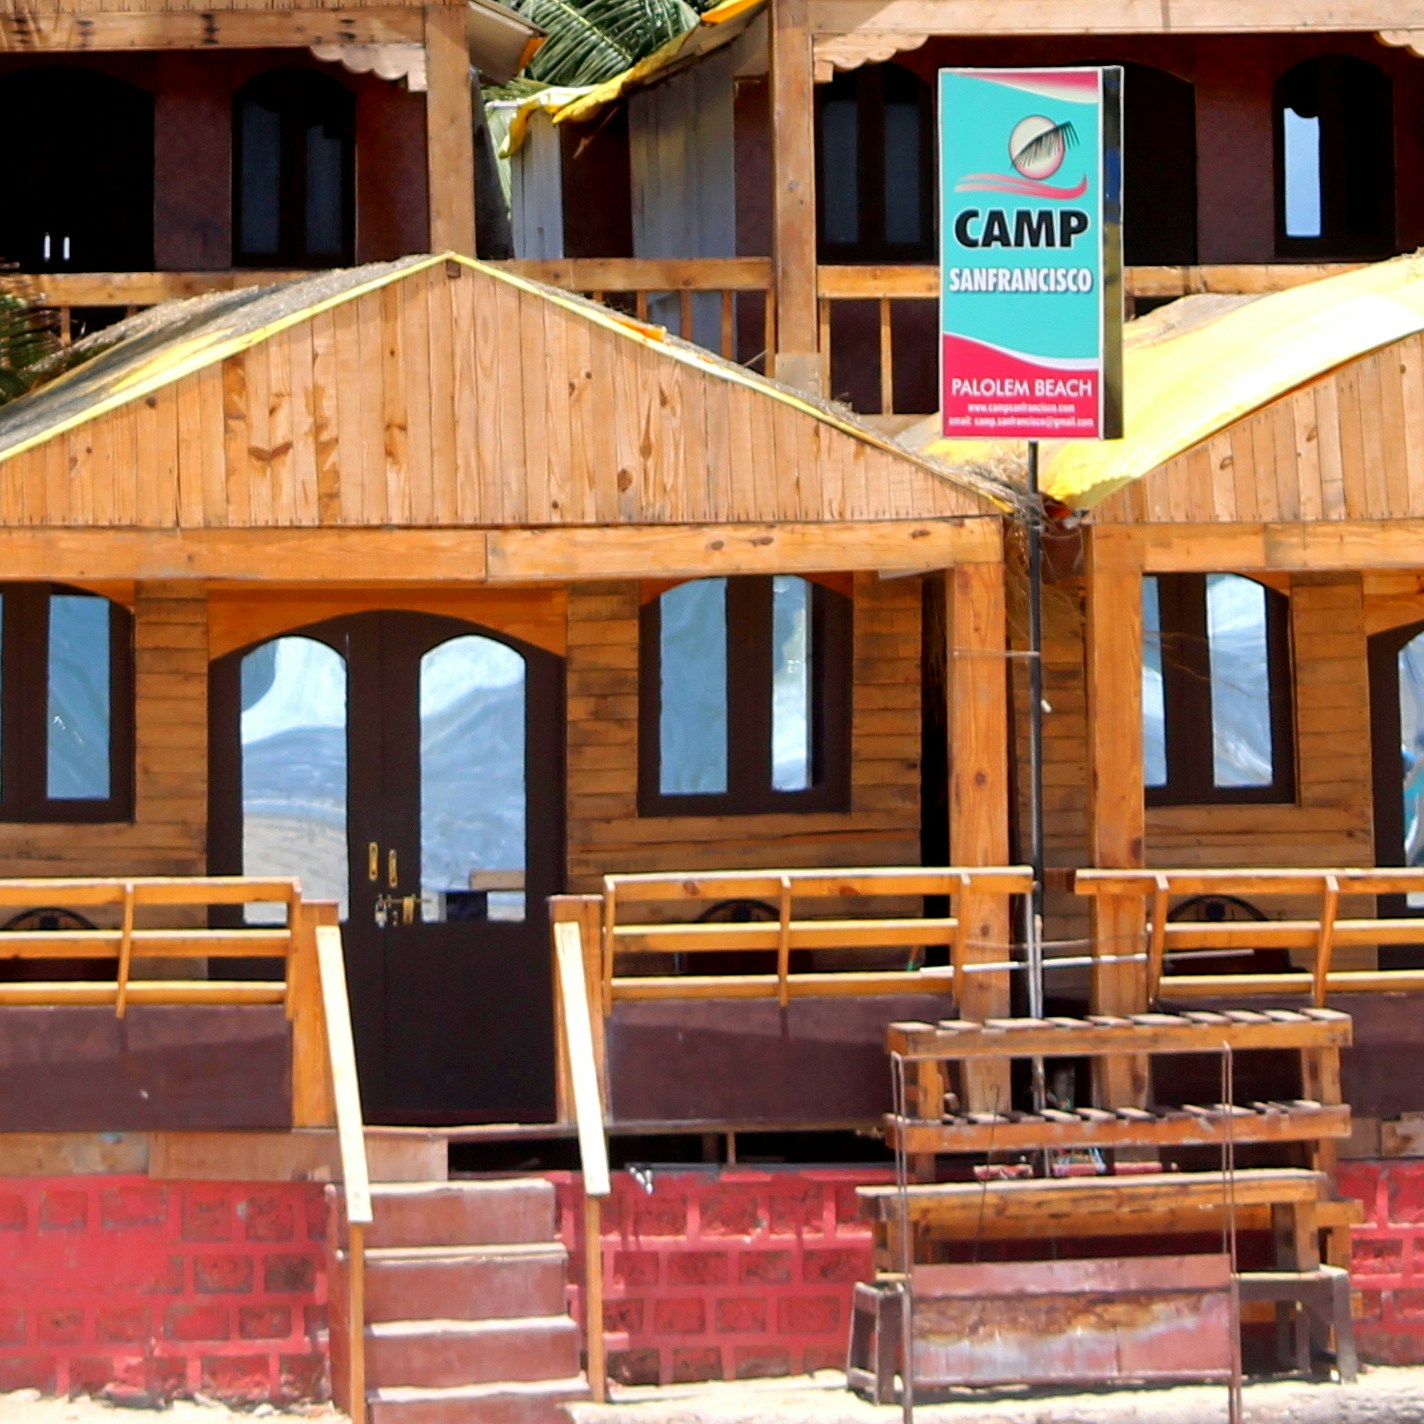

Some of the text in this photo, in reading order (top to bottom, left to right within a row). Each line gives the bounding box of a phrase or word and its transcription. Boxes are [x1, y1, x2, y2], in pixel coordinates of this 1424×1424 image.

[953, 207, 1089, 249] CAMP
[949, 267, 1094, 294] SANFRANCISCO
[951, 377, 1093, 397] PALOLEM BEACH
